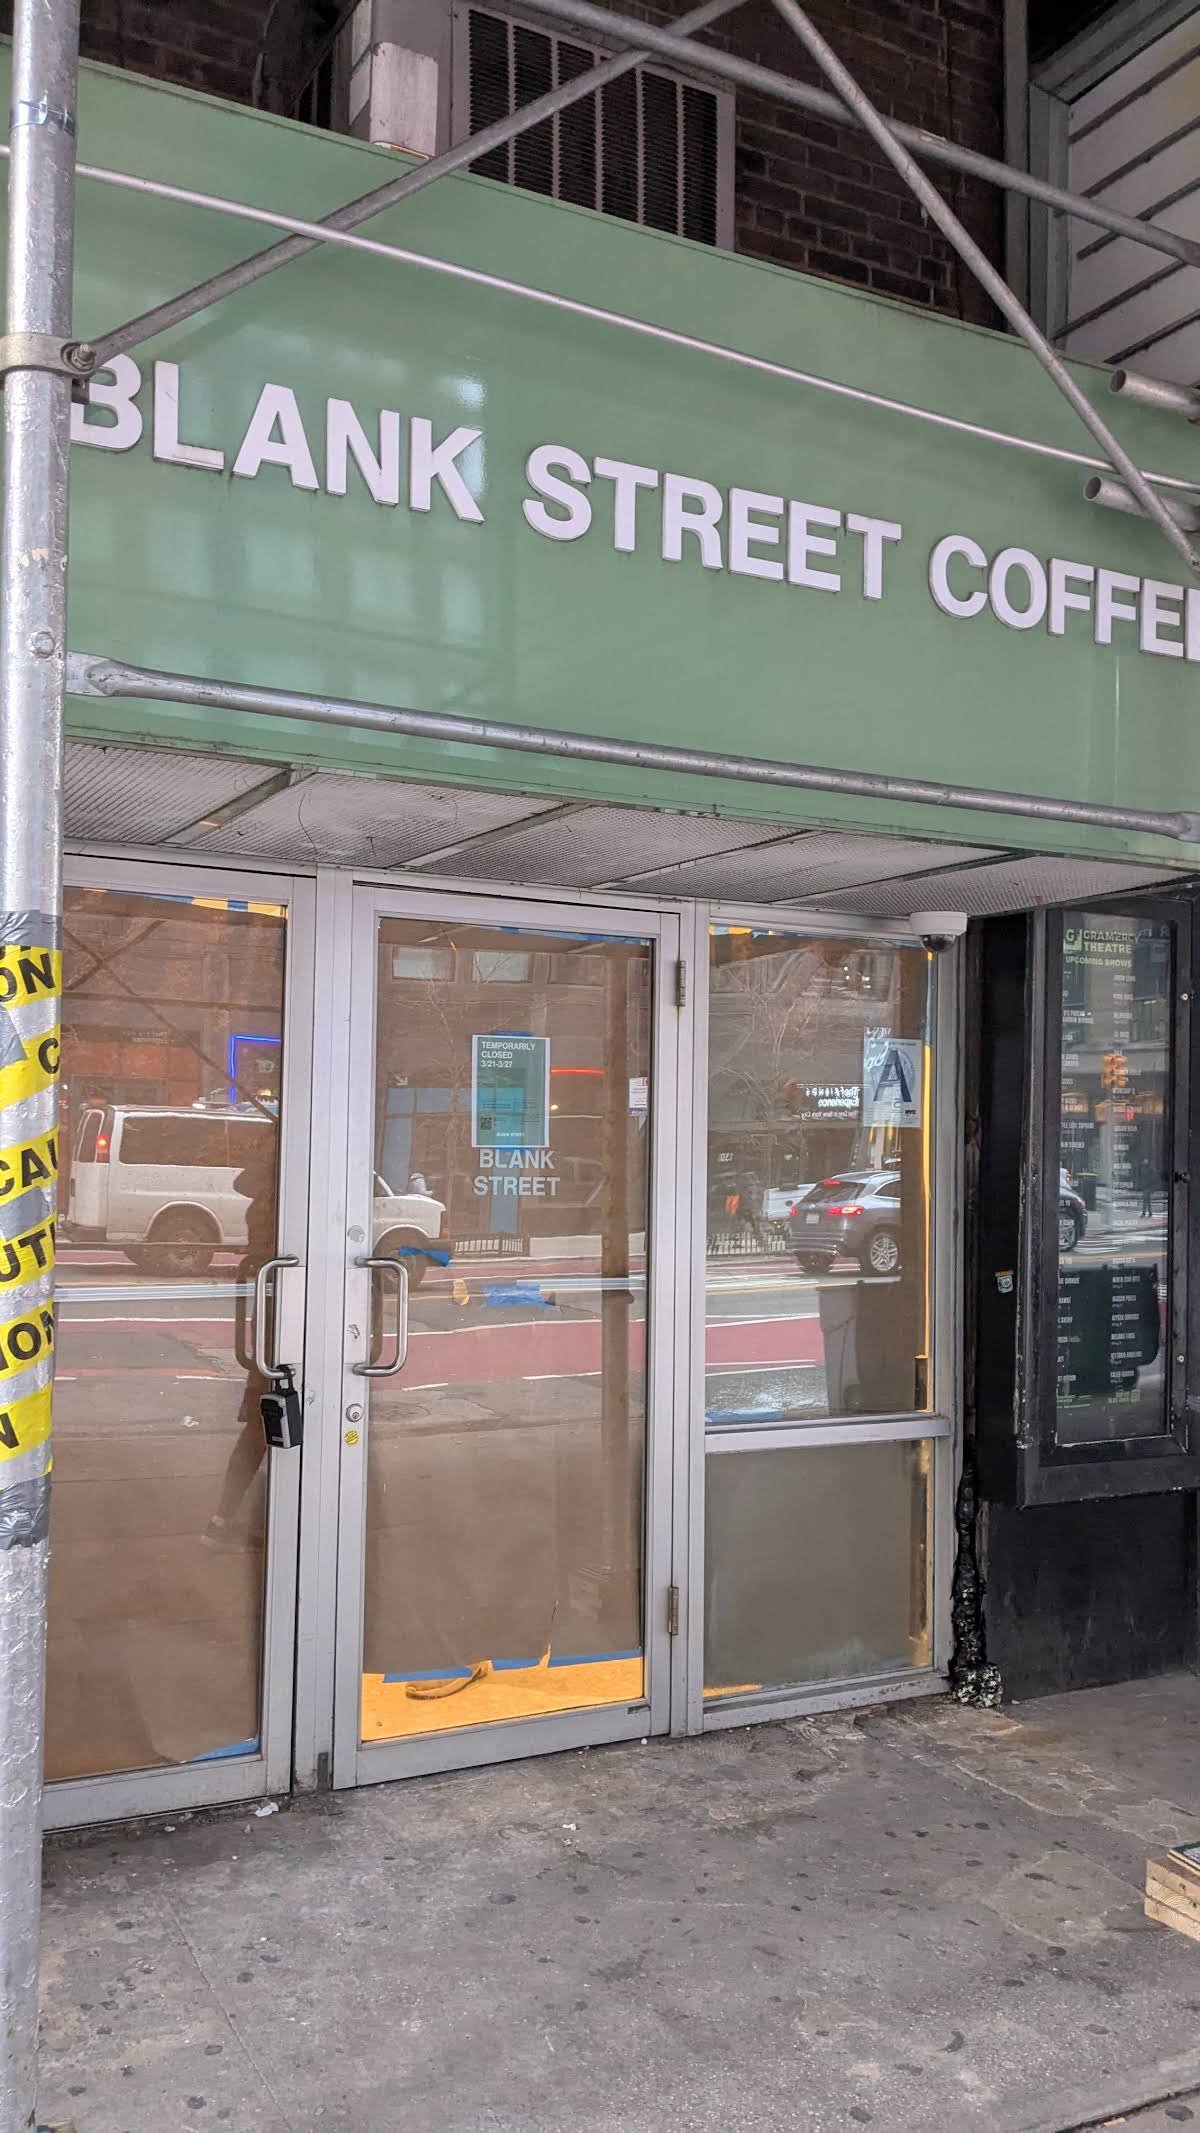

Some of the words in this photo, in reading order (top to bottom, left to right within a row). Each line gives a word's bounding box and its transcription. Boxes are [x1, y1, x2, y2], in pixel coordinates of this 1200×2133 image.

[70, 352, 485, 523] BLANK
[522, 444, 902, 600] STREET
[1083, 929, 1140, 944] GRAMERCY
[1083, 941, 1133, 954] THEATRE
[1105, 958, 1133, 968] SHOWS
[481, 1041, 536, 1051] TEMPORARILY
[481, 1051, 513, 1059] CLOSED
[481, 1060, 513, 1068] 3/21-3/27
[873, 1049, 912, 1103] A
[479, 1149, 555, 1169] BLANK
[473, 1176, 560, 1196] STREET
